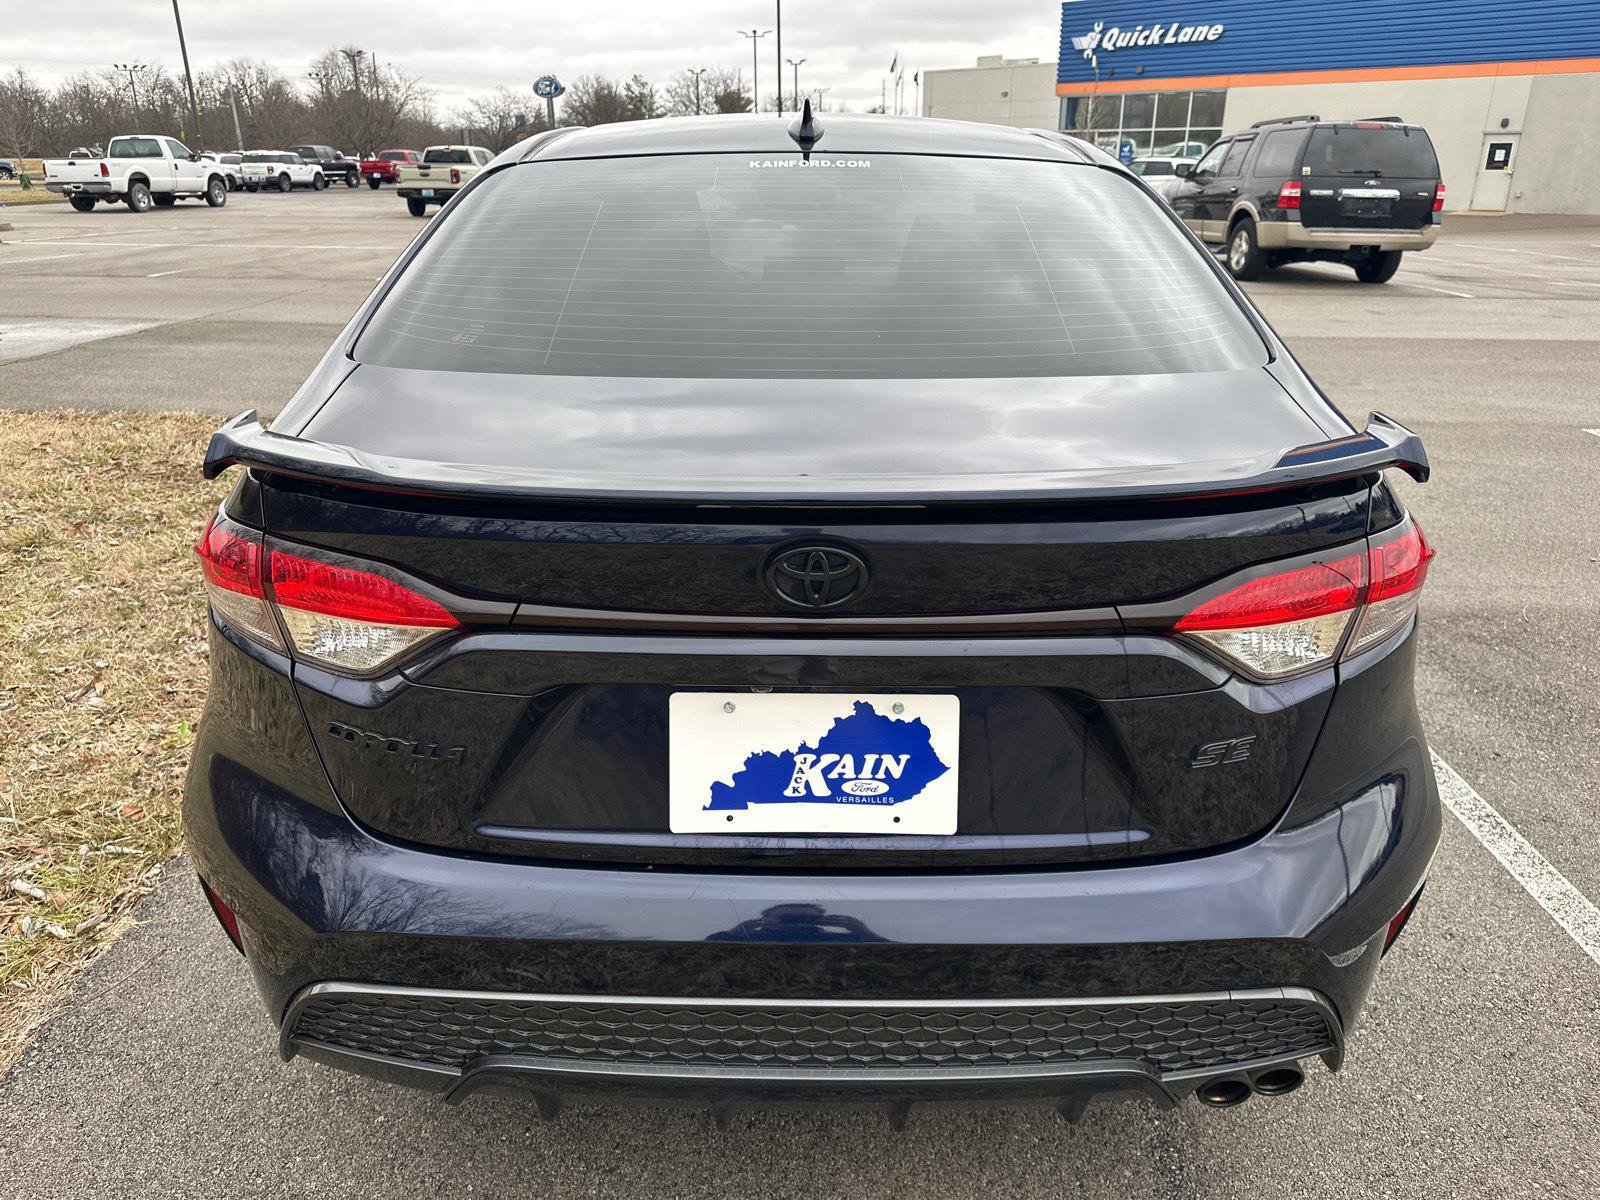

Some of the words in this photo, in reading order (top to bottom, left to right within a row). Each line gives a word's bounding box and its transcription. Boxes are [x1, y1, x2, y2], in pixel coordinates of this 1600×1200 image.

[1101, 24, 1165, 51] Quick
[1163, 22, 1224, 45] Lane
[749, 159, 871, 169] KAINFORD.COM
[1190, 735, 1257, 769] SE
[782, 753, 911, 797] KAIN
[791, 756, 808, 795] JACK
[850, 781, 880, 794] Ford
[835, 796, 895, 804] VERSAILLES
